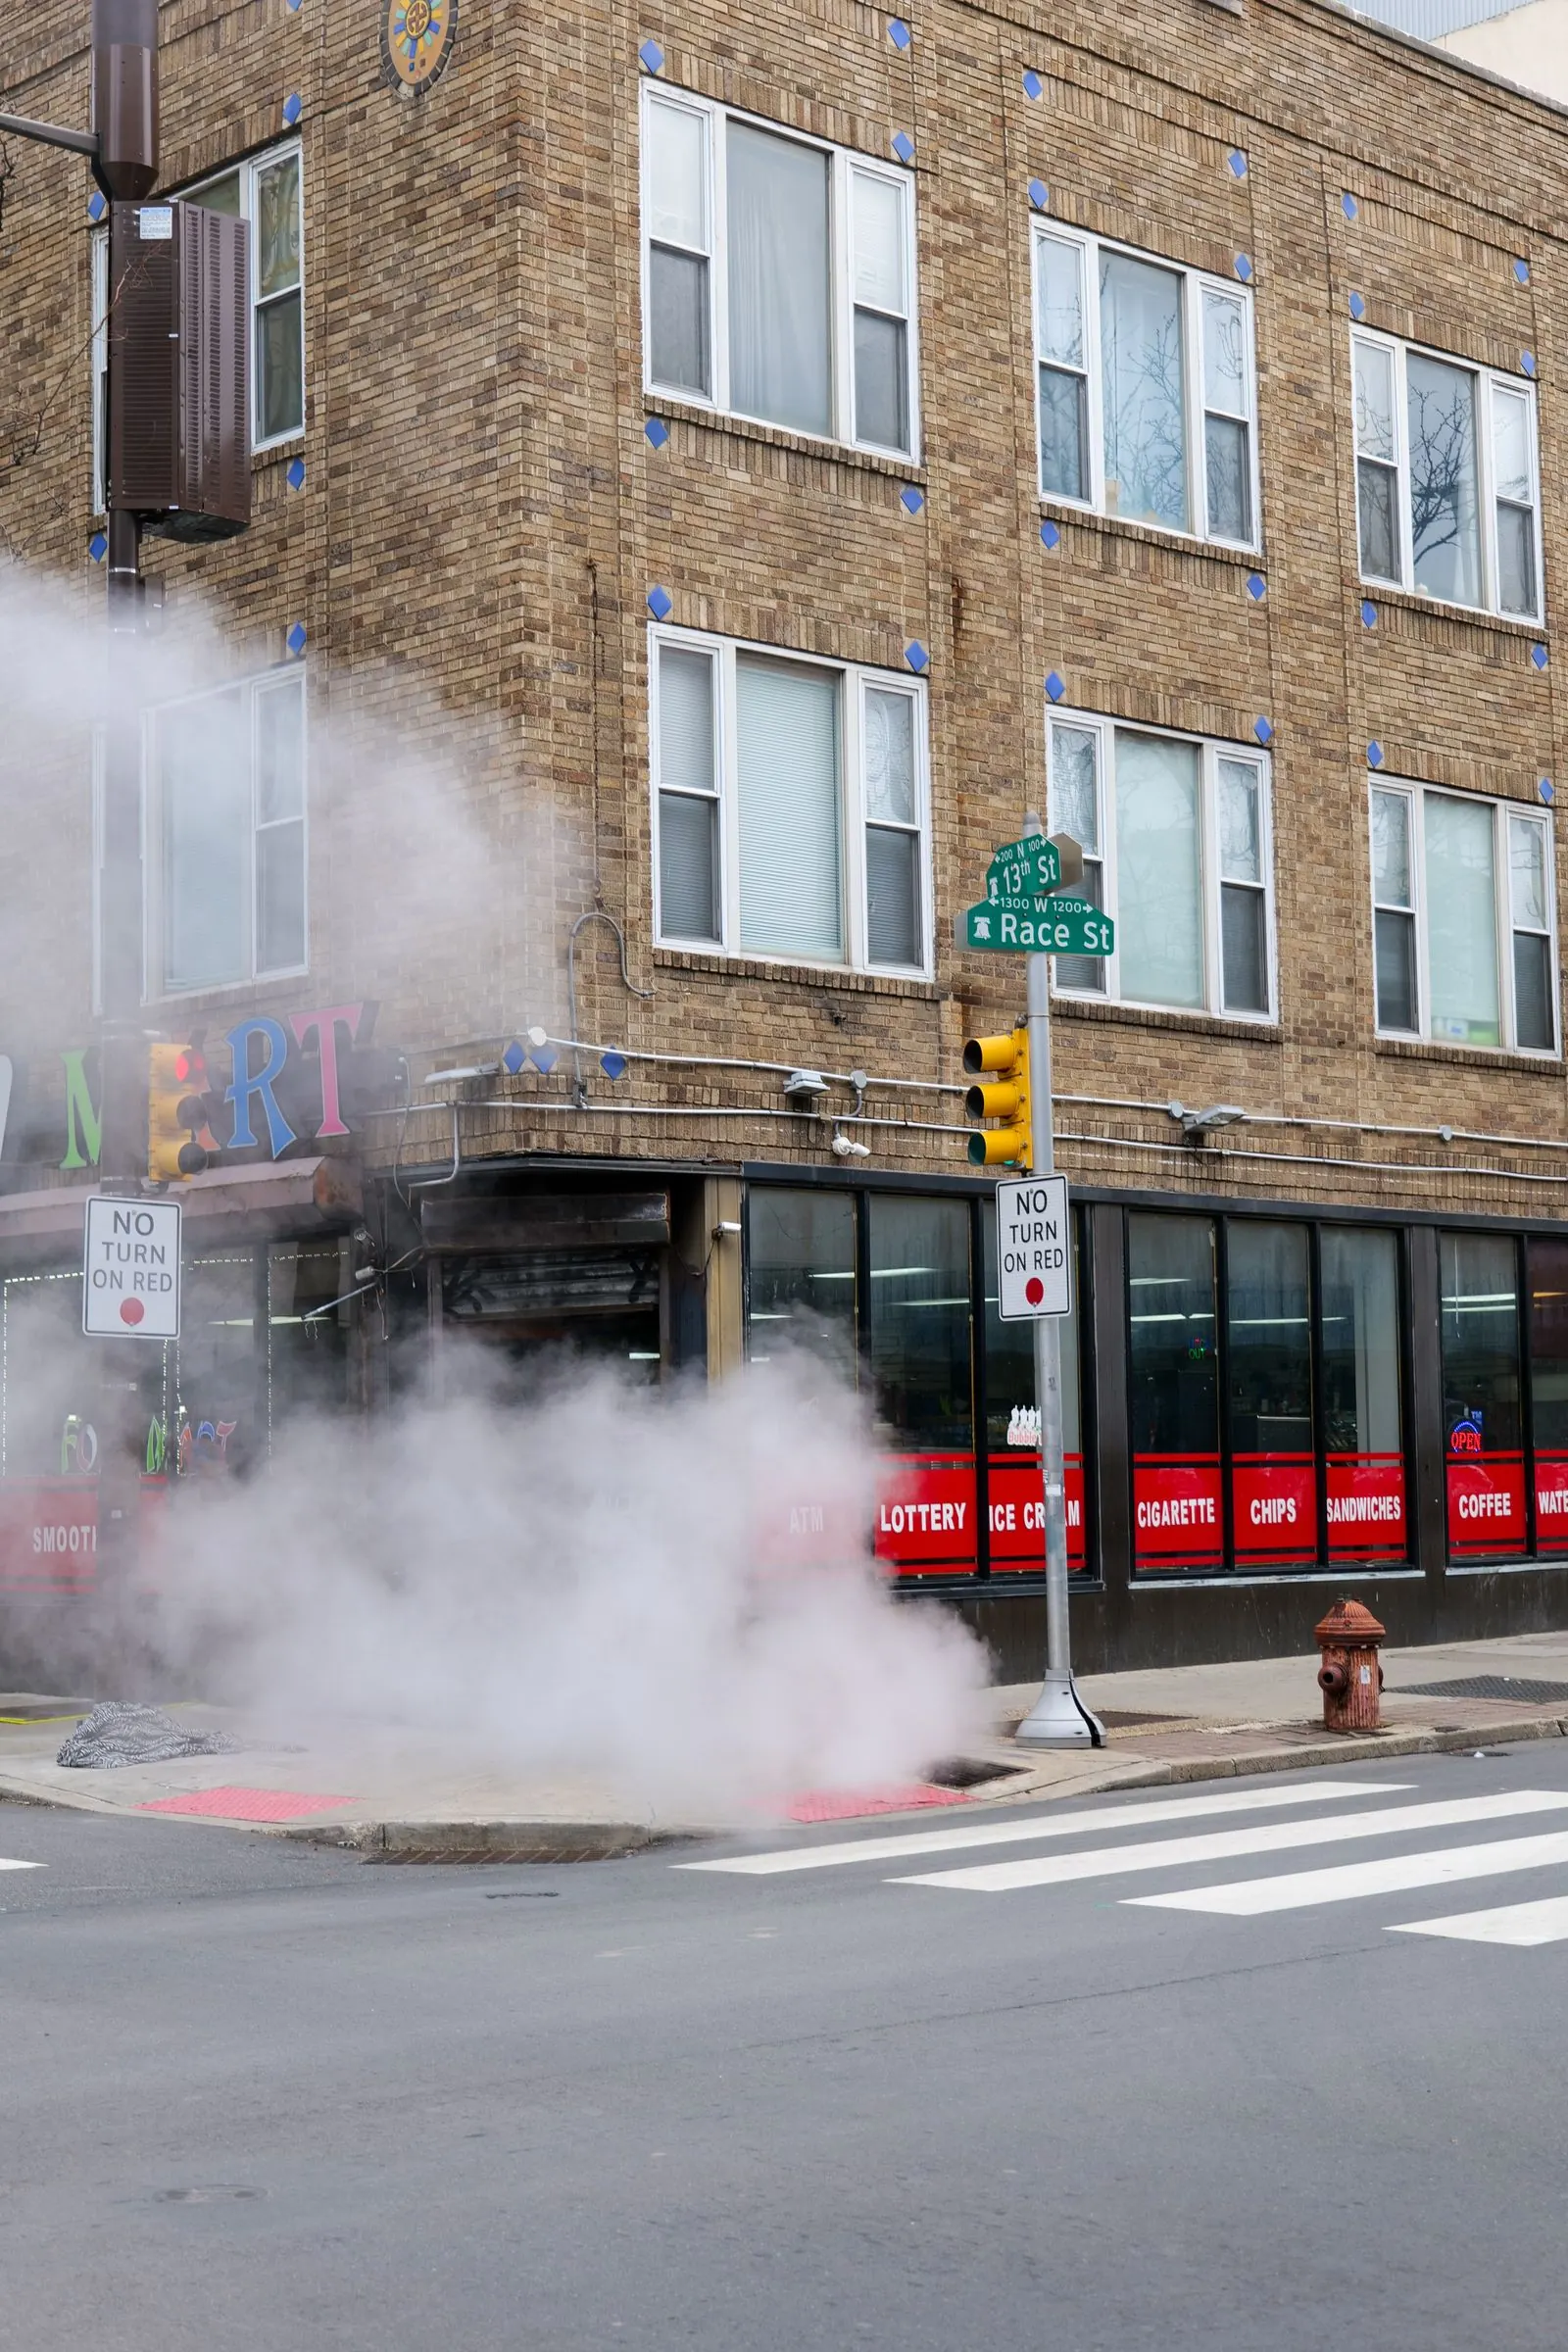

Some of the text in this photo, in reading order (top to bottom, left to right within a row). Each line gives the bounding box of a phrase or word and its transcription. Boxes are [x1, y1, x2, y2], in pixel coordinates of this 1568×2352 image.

[1000, 838, 1040, 863] 200 N 100
[1003, 855, 1056, 895] 13th St
[1000, 897, 1082, 913] 1300 W 1200
[1001, 912, 1110, 950] Race St
[1016, 1189, 1048, 1216] NO
[113, 1210, 154, 1236] NO
[1009, 1220, 1057, 1245] TURN
[102, 1242, 166, 1265] TURN
[1004, 1249, 1063, 1273] ON RED
[92, 1269, 172, 1293] ON RED
[1008, 1431, 1037, 1444] Bubble
[1450, 1432, 1482, 1450] OPEN
[880, 1502, 966, 1534] LOTTERY
[988, 1499, 1081, 1533] ICE CRM
[1137, 1497, 1215, 1529] CIGARETTE
[1250, 1497, 1297, 1525] CHIPS
[1326, 1495, 1401, 1523] SANDWICHES
[1458, 1493, 1512, 1519] COFFEE
[789, 1505, 824, 1535] ATM
